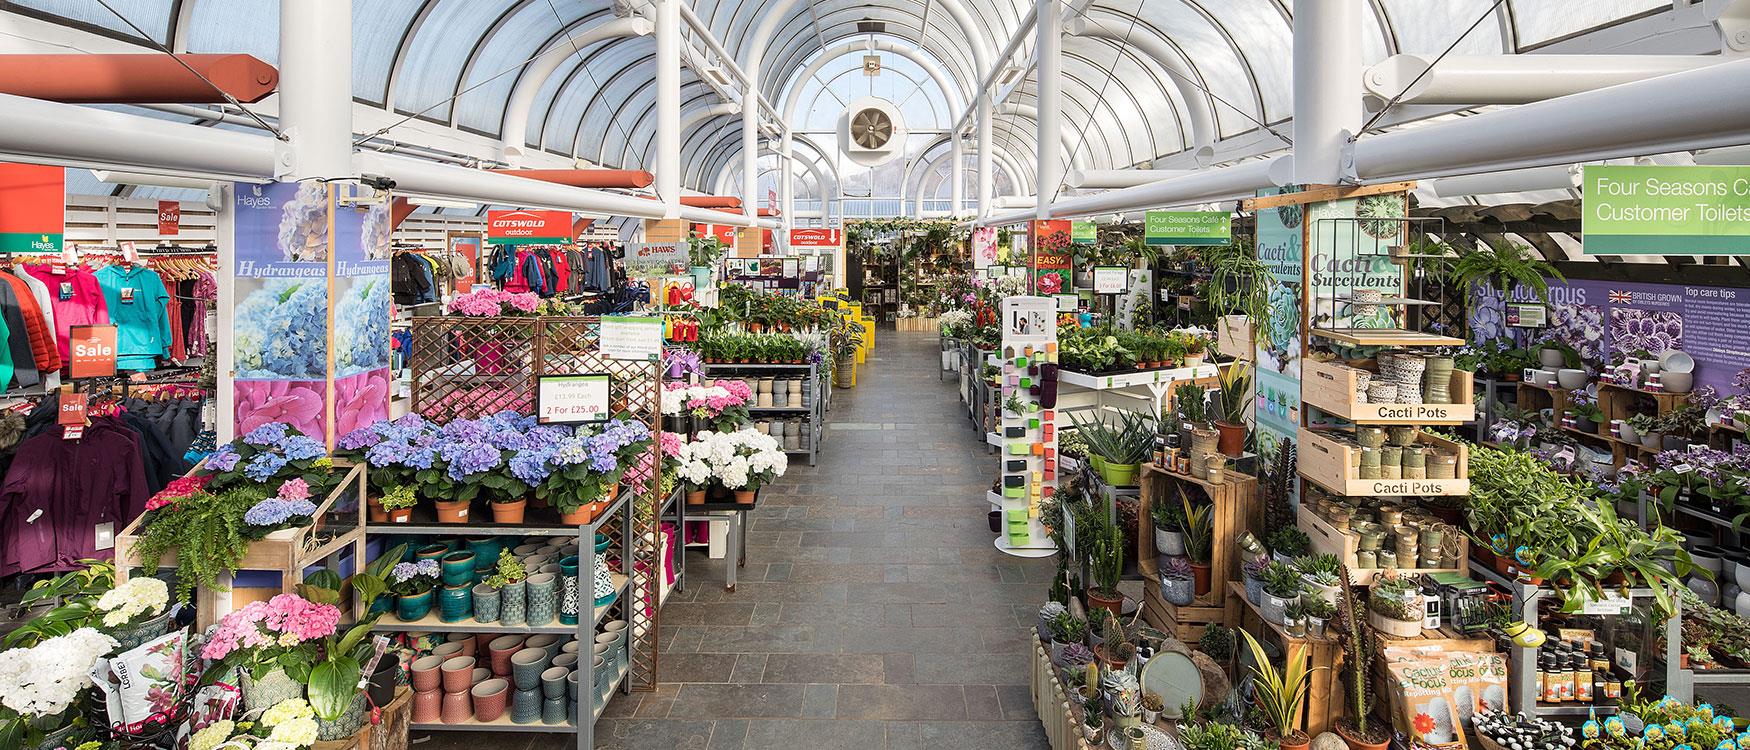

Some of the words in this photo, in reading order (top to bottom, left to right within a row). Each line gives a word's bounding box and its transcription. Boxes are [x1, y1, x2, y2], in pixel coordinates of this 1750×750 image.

[1597, 178, 1640, 196] Four
[1645, 178, 1728, 196] Seasons
[237, 195, 270, 208] Hayes
[160, 212, 178, 222] Sale
[1596, 202, 1690, 221] Customer
[1696, 204, 1750, 221] Toilets
[32, 241, 54, 250] Hayes
[1258, 243, 1286, 261] Cacti
[1286, 234, 1302, 262] &
[237, 260, 326, 278] Hydrangeas
[336, 260, 388, 278] Hydrangeas
[1310, 253, 1372, 273] Cacti
[1312, 273, 1400, 288] Succulents
[1632, 292, 1656, 300] BRITISH
[1657, 294, 1682, 302] GROWN
[1684, 286, 1698, 298] Top
[1700, 289, 1718, 298] care
[1720, 289, 1736, 300] tips
[75, 344, 112, 357] Sale
[571, 405, 599, 413] £25.00
[1378, 407, 1412, 418] Cacti
[1417, 407, 1447, 418] Pots
[1374, 482, 1408, 494] Cacti
[1413, 482, 1442, 494] Pots
[1449, 668, 1475, 678] ocus
[1412, 678, 1446, 688] Focus
